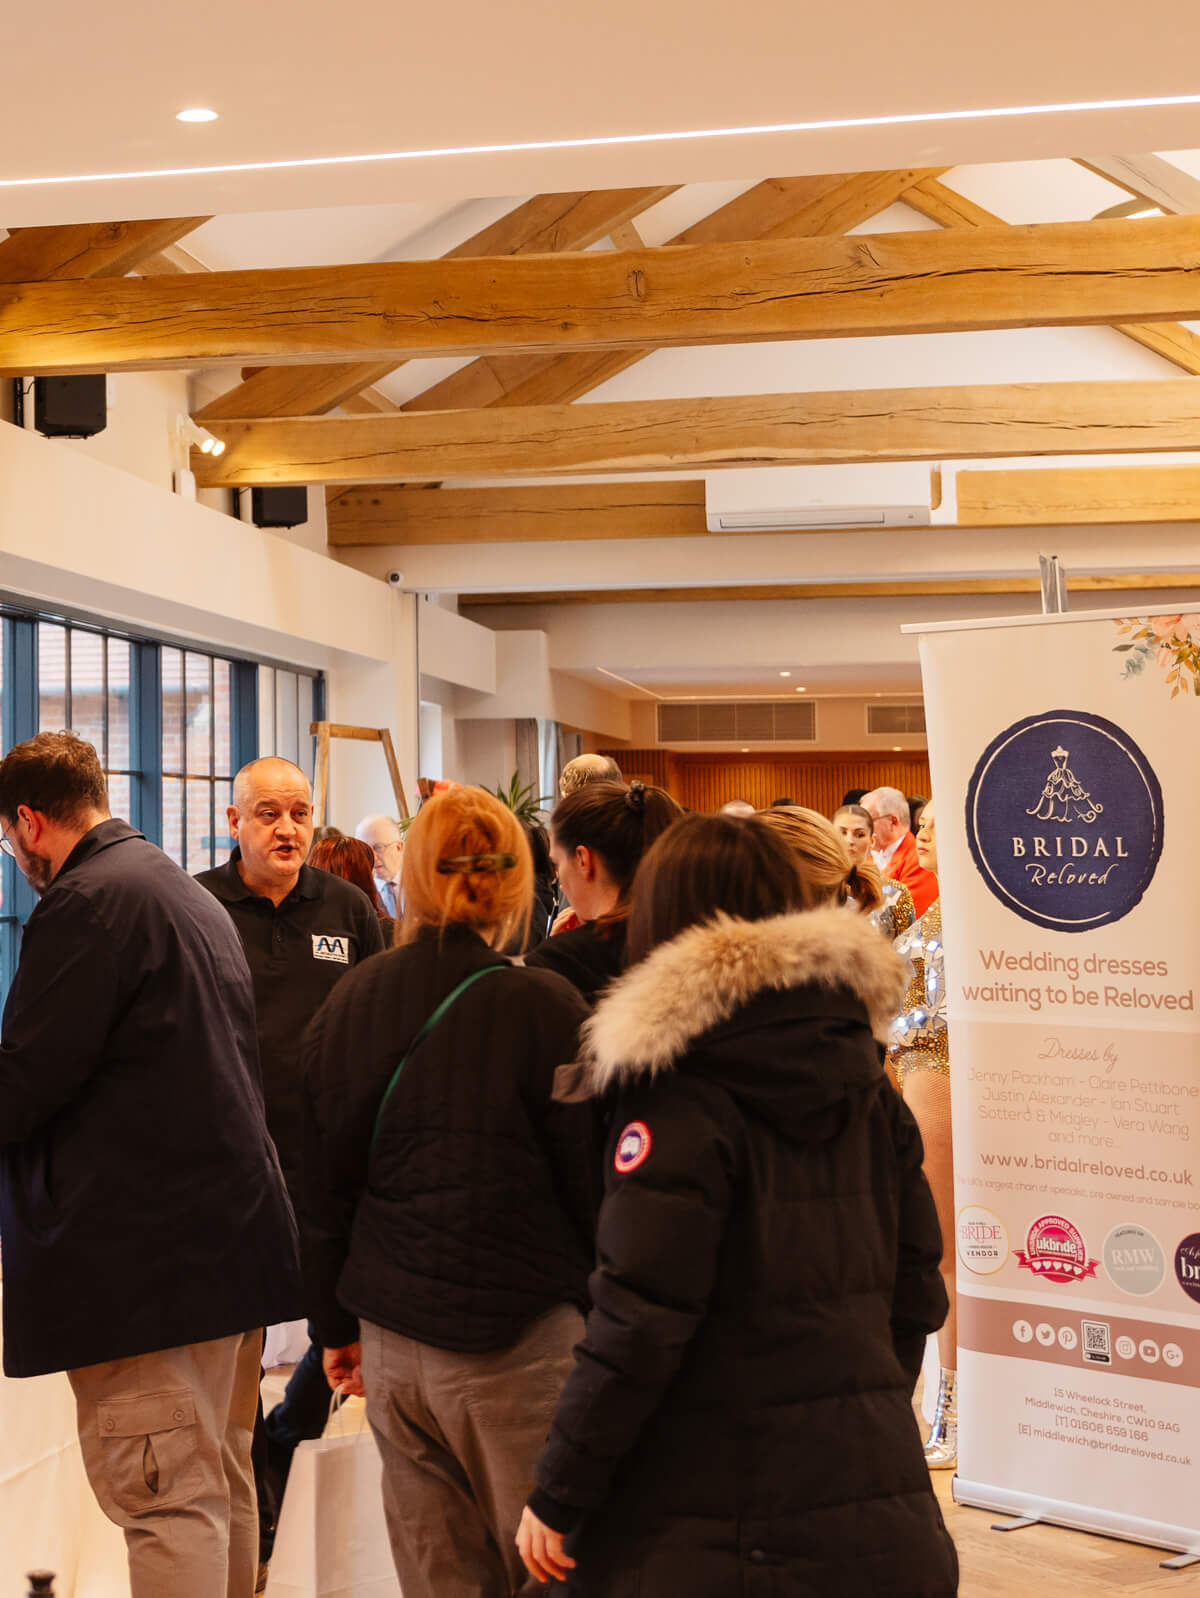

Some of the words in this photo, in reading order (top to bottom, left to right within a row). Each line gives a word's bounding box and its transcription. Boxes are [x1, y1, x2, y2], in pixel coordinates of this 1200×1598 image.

[1011, 836, 1129, 857] BRIDAL
[1025, 862, 1119, 886] Reloved
[979, 950, 1080, 981] Wedding
[1084, 953, 1169, 977] dresses
[961, 982, 1042, 1011] waiting
[1046, 984, 1068, 1004] to
[1072, 984, 1099, 1006] be
[1104, 985, 1194, 1011] Reloved
[1038, 1037, 1099, 1060] Dresses
[1102, 1042, 1119, 1073] by
[983, 1086, 1025, 1103] Justin
[1028, 1089, 1097, 1108] Alexander
[1134, 1097, 1179, 1116] Stuart
[1048, 1130, 1075, 1145] and
[1113, 1115, 1145, 1132] Vera
[1148, 1119, 1190, 1141] Wang
[980, 1152, 1193, 1186] www.bridalreloved.co.uk
[960, 1225, 1002, 1244] BRIDE
[1036, 1237, 1077, 1254] ukbride
[1111, 1248, 1154, 1265] RMW
[1066, 1390, 1112, 1407] Wheelock
[1055, 1414, 1069, 1429] [T]
[1126, 1415, 1156, 1429] CW10
[1018, 1423, 1032, 1437] [E]
[1033, 1428, 1192, 1466] middlewich@bridalreloved.co.uk
